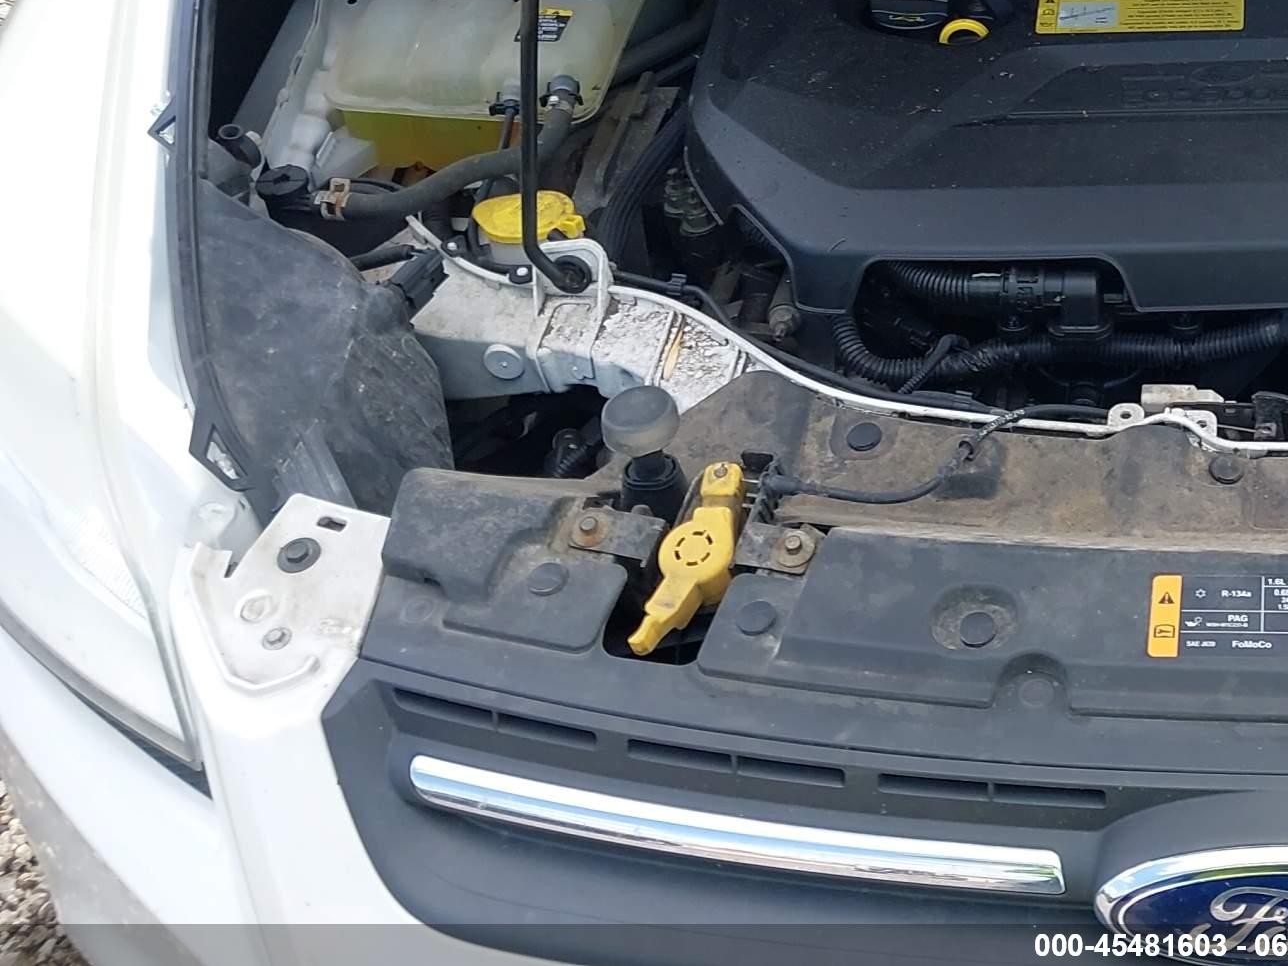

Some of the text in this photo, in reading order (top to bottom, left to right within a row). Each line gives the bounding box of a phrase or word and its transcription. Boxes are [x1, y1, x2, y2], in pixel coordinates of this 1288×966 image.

[1221, 589, 1252, 598] R-134a
[1227, 614, 1249, 622] PAG
[1231, 640, 1272, 649] FoMoCo
